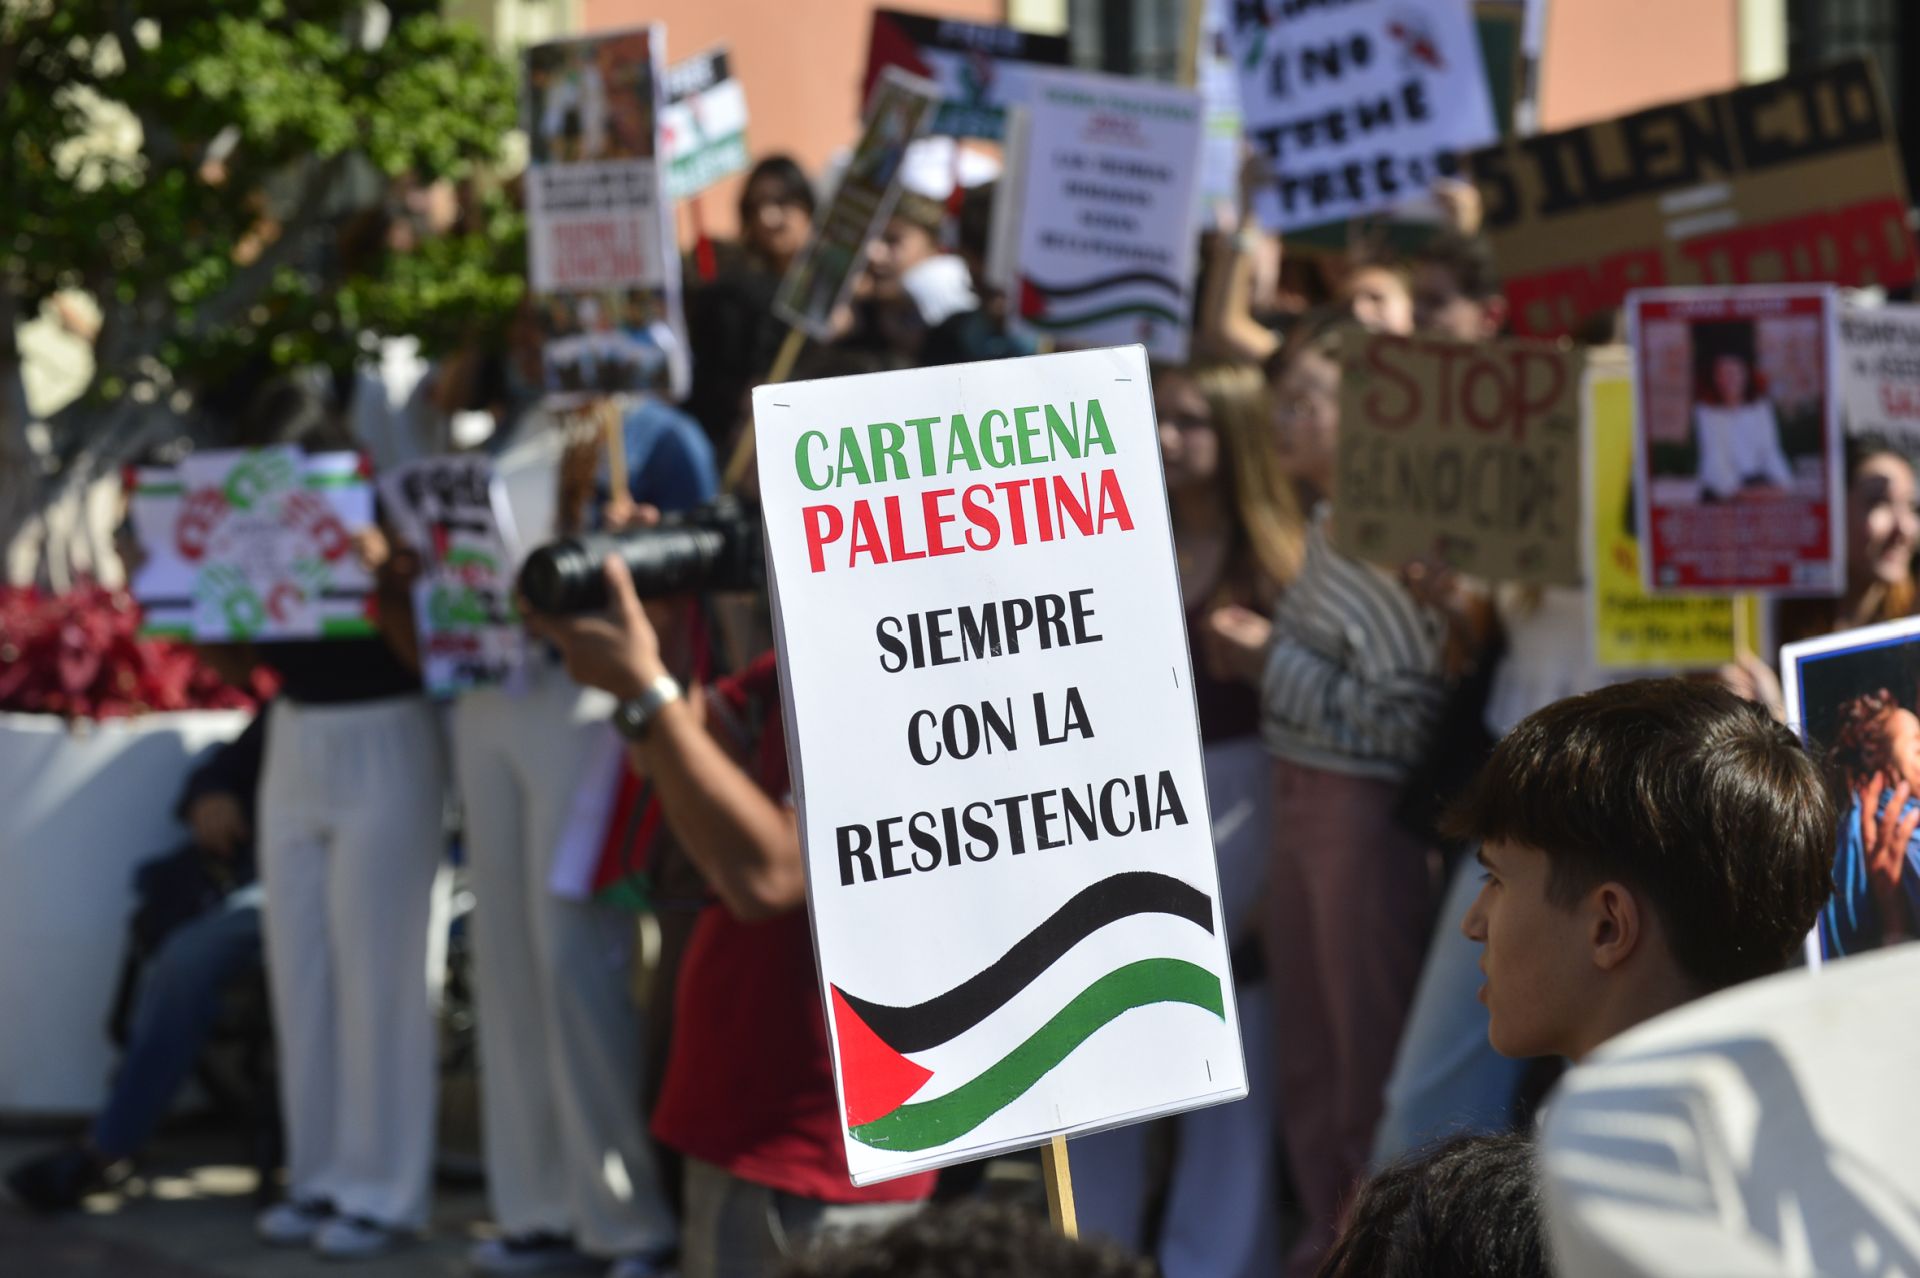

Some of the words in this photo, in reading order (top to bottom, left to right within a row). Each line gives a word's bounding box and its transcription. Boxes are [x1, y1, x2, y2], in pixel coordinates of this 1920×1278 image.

[1363, 333, 1567, 444] STOP
[794, 398, 1117, 491] CARTAGENA
[801, 468, 1135, 573] PALESTINA
[875, 588, 1103, 673] SIEMPRE
[907, 697, 1018, 766] CON
[1032, 686, 1095, 747] LA
[835, 769, 1189, 887] RESISTENCIA
